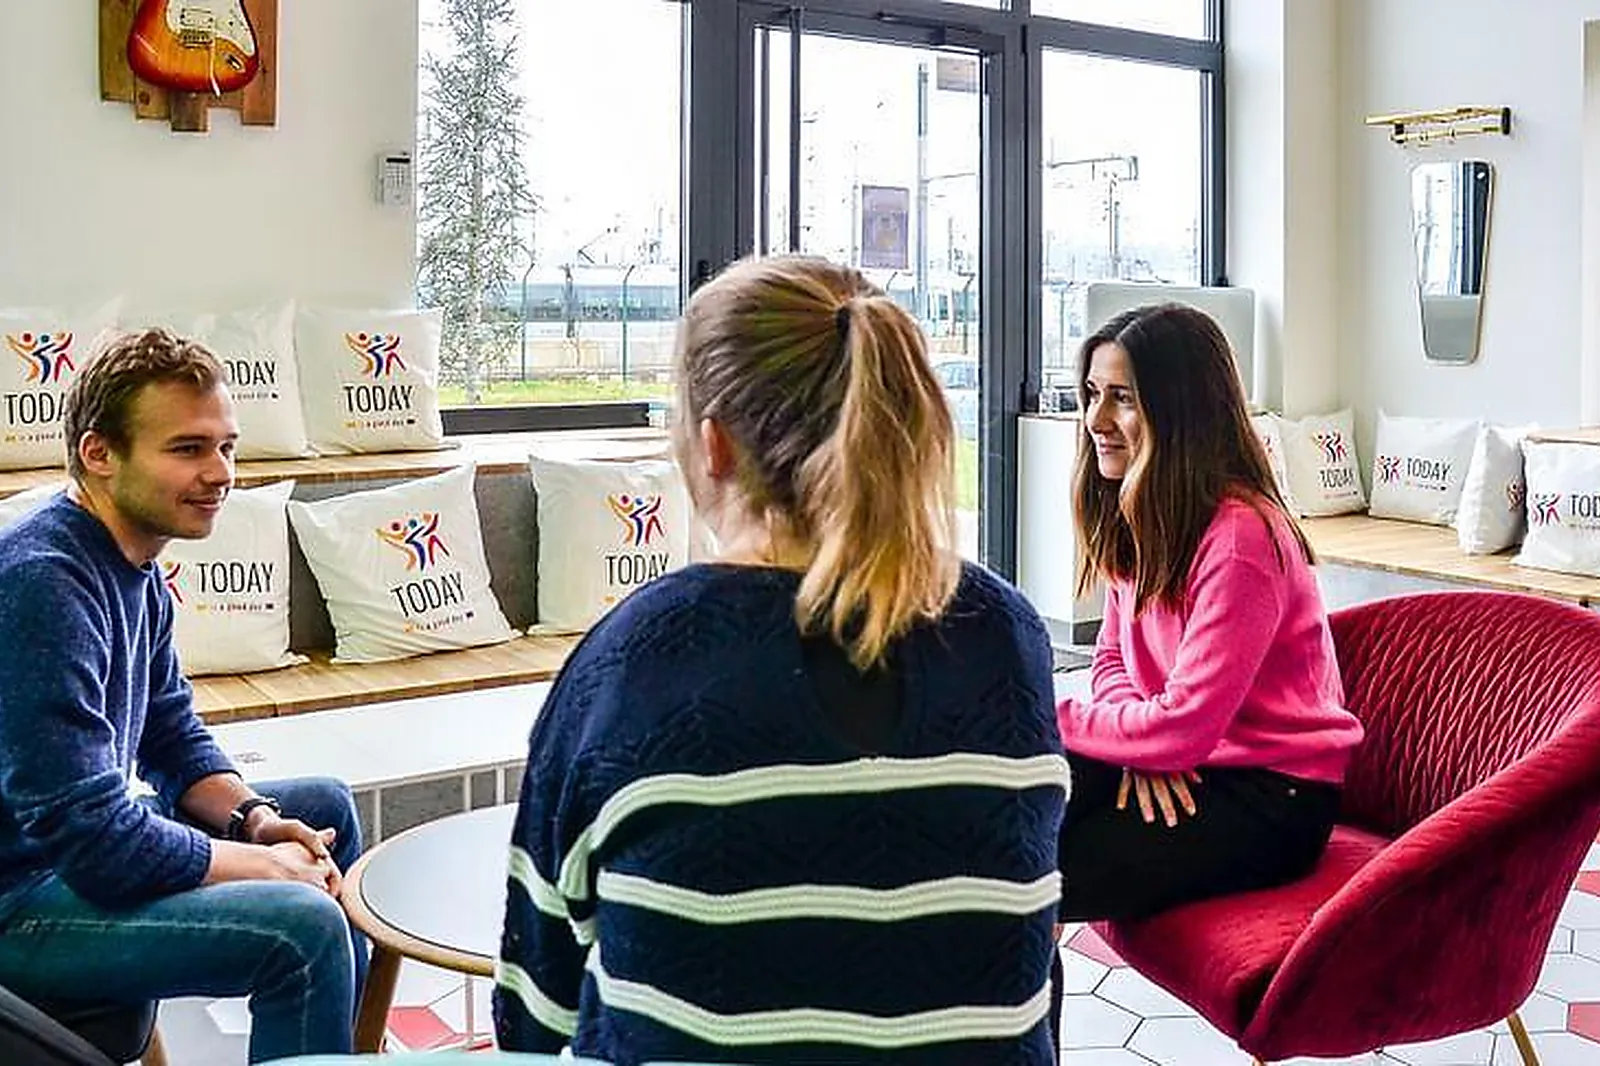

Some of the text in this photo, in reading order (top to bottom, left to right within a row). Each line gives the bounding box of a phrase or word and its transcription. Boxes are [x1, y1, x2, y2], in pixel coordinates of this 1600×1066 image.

[224, 361, 275, 387] ODAY
[4, 391, 66, 425] TODA
[343, 385, 412, 413] TODAY
[1319, 468, 1353, 488] TODAY
[1408, 457, 1450, 481] TODAY
[1570, 494, 1600, 518] TOD
[195, 562, 274, 594] TODAY
[604, 553, 669, 586] TODAY
[390, 572, 464, 618] TODAY
